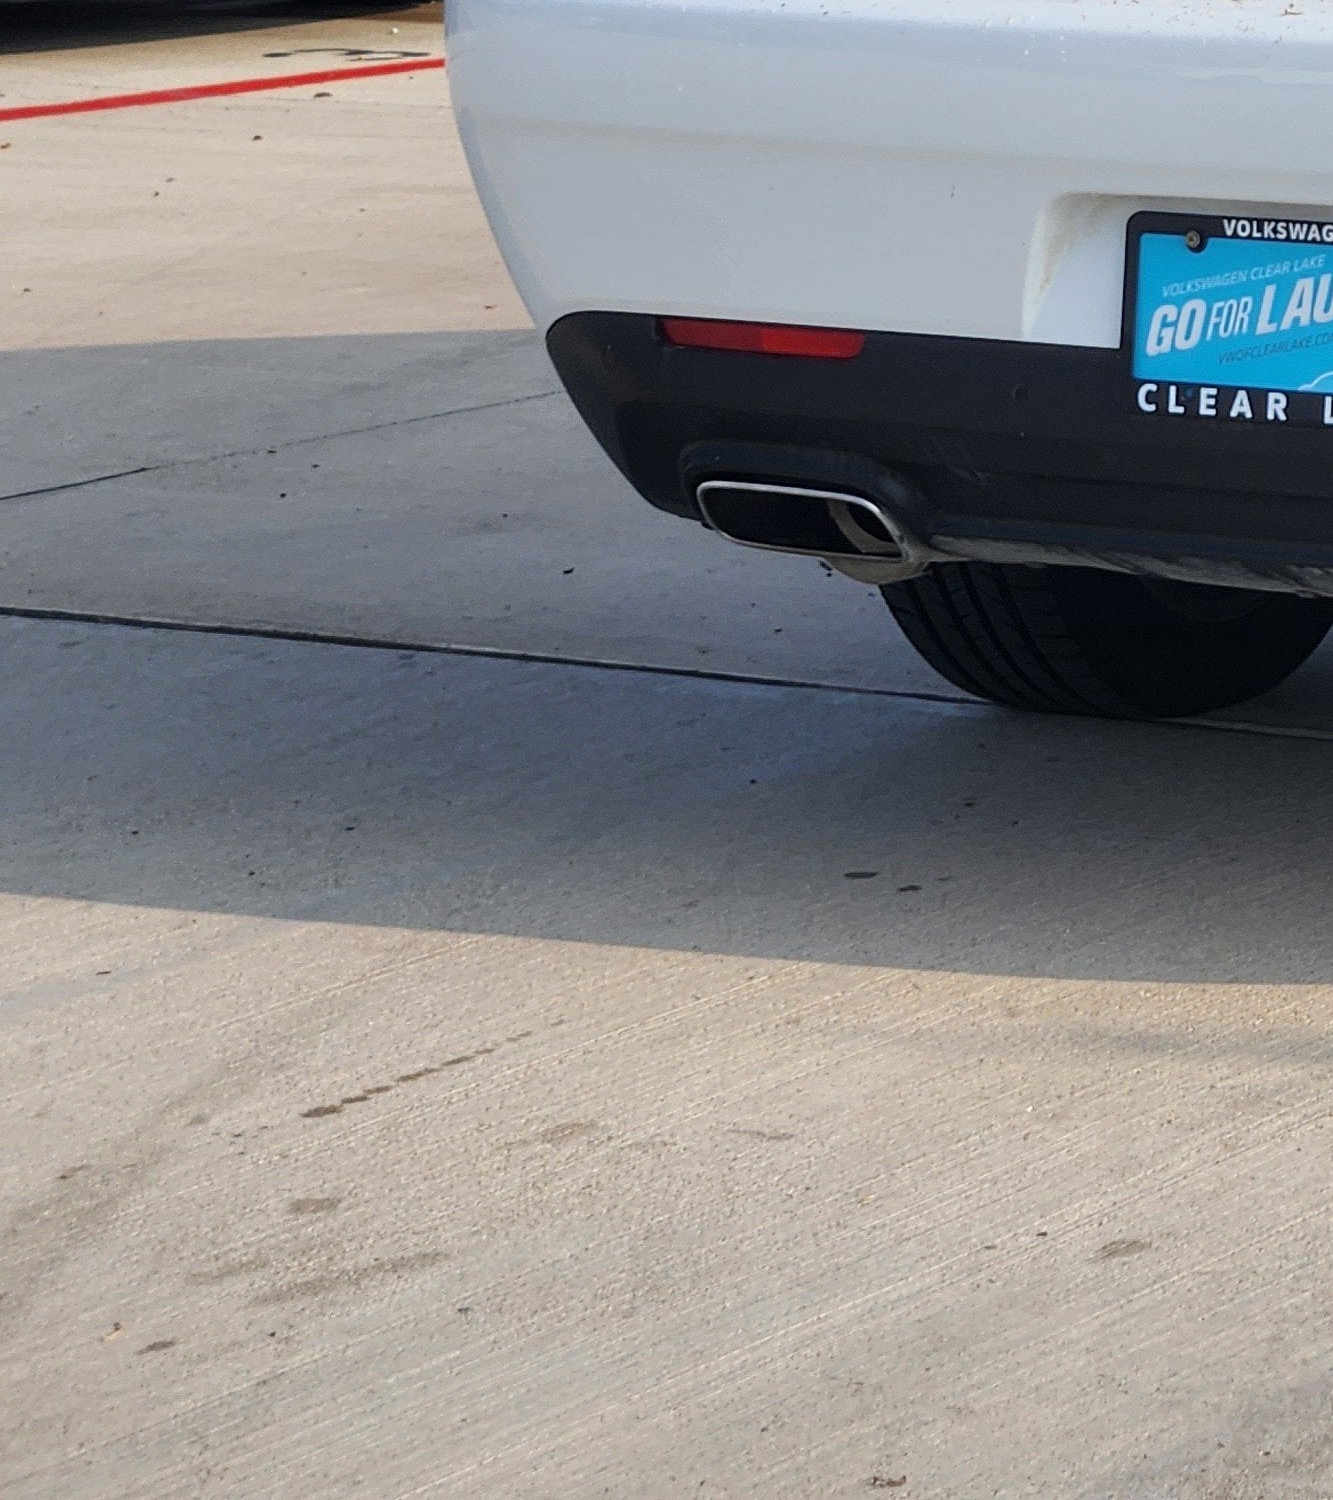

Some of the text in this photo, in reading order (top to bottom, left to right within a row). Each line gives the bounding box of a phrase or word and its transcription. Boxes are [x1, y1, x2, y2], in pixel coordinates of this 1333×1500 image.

[1161, 253, 1327, 298] VOLKSWAGEN CLEAR LAKE
[1146, 297, 1207, 357] GO
[1206, 295, 1254, 342] FOR
[1136, 382, 1289, 421] CLEAR
